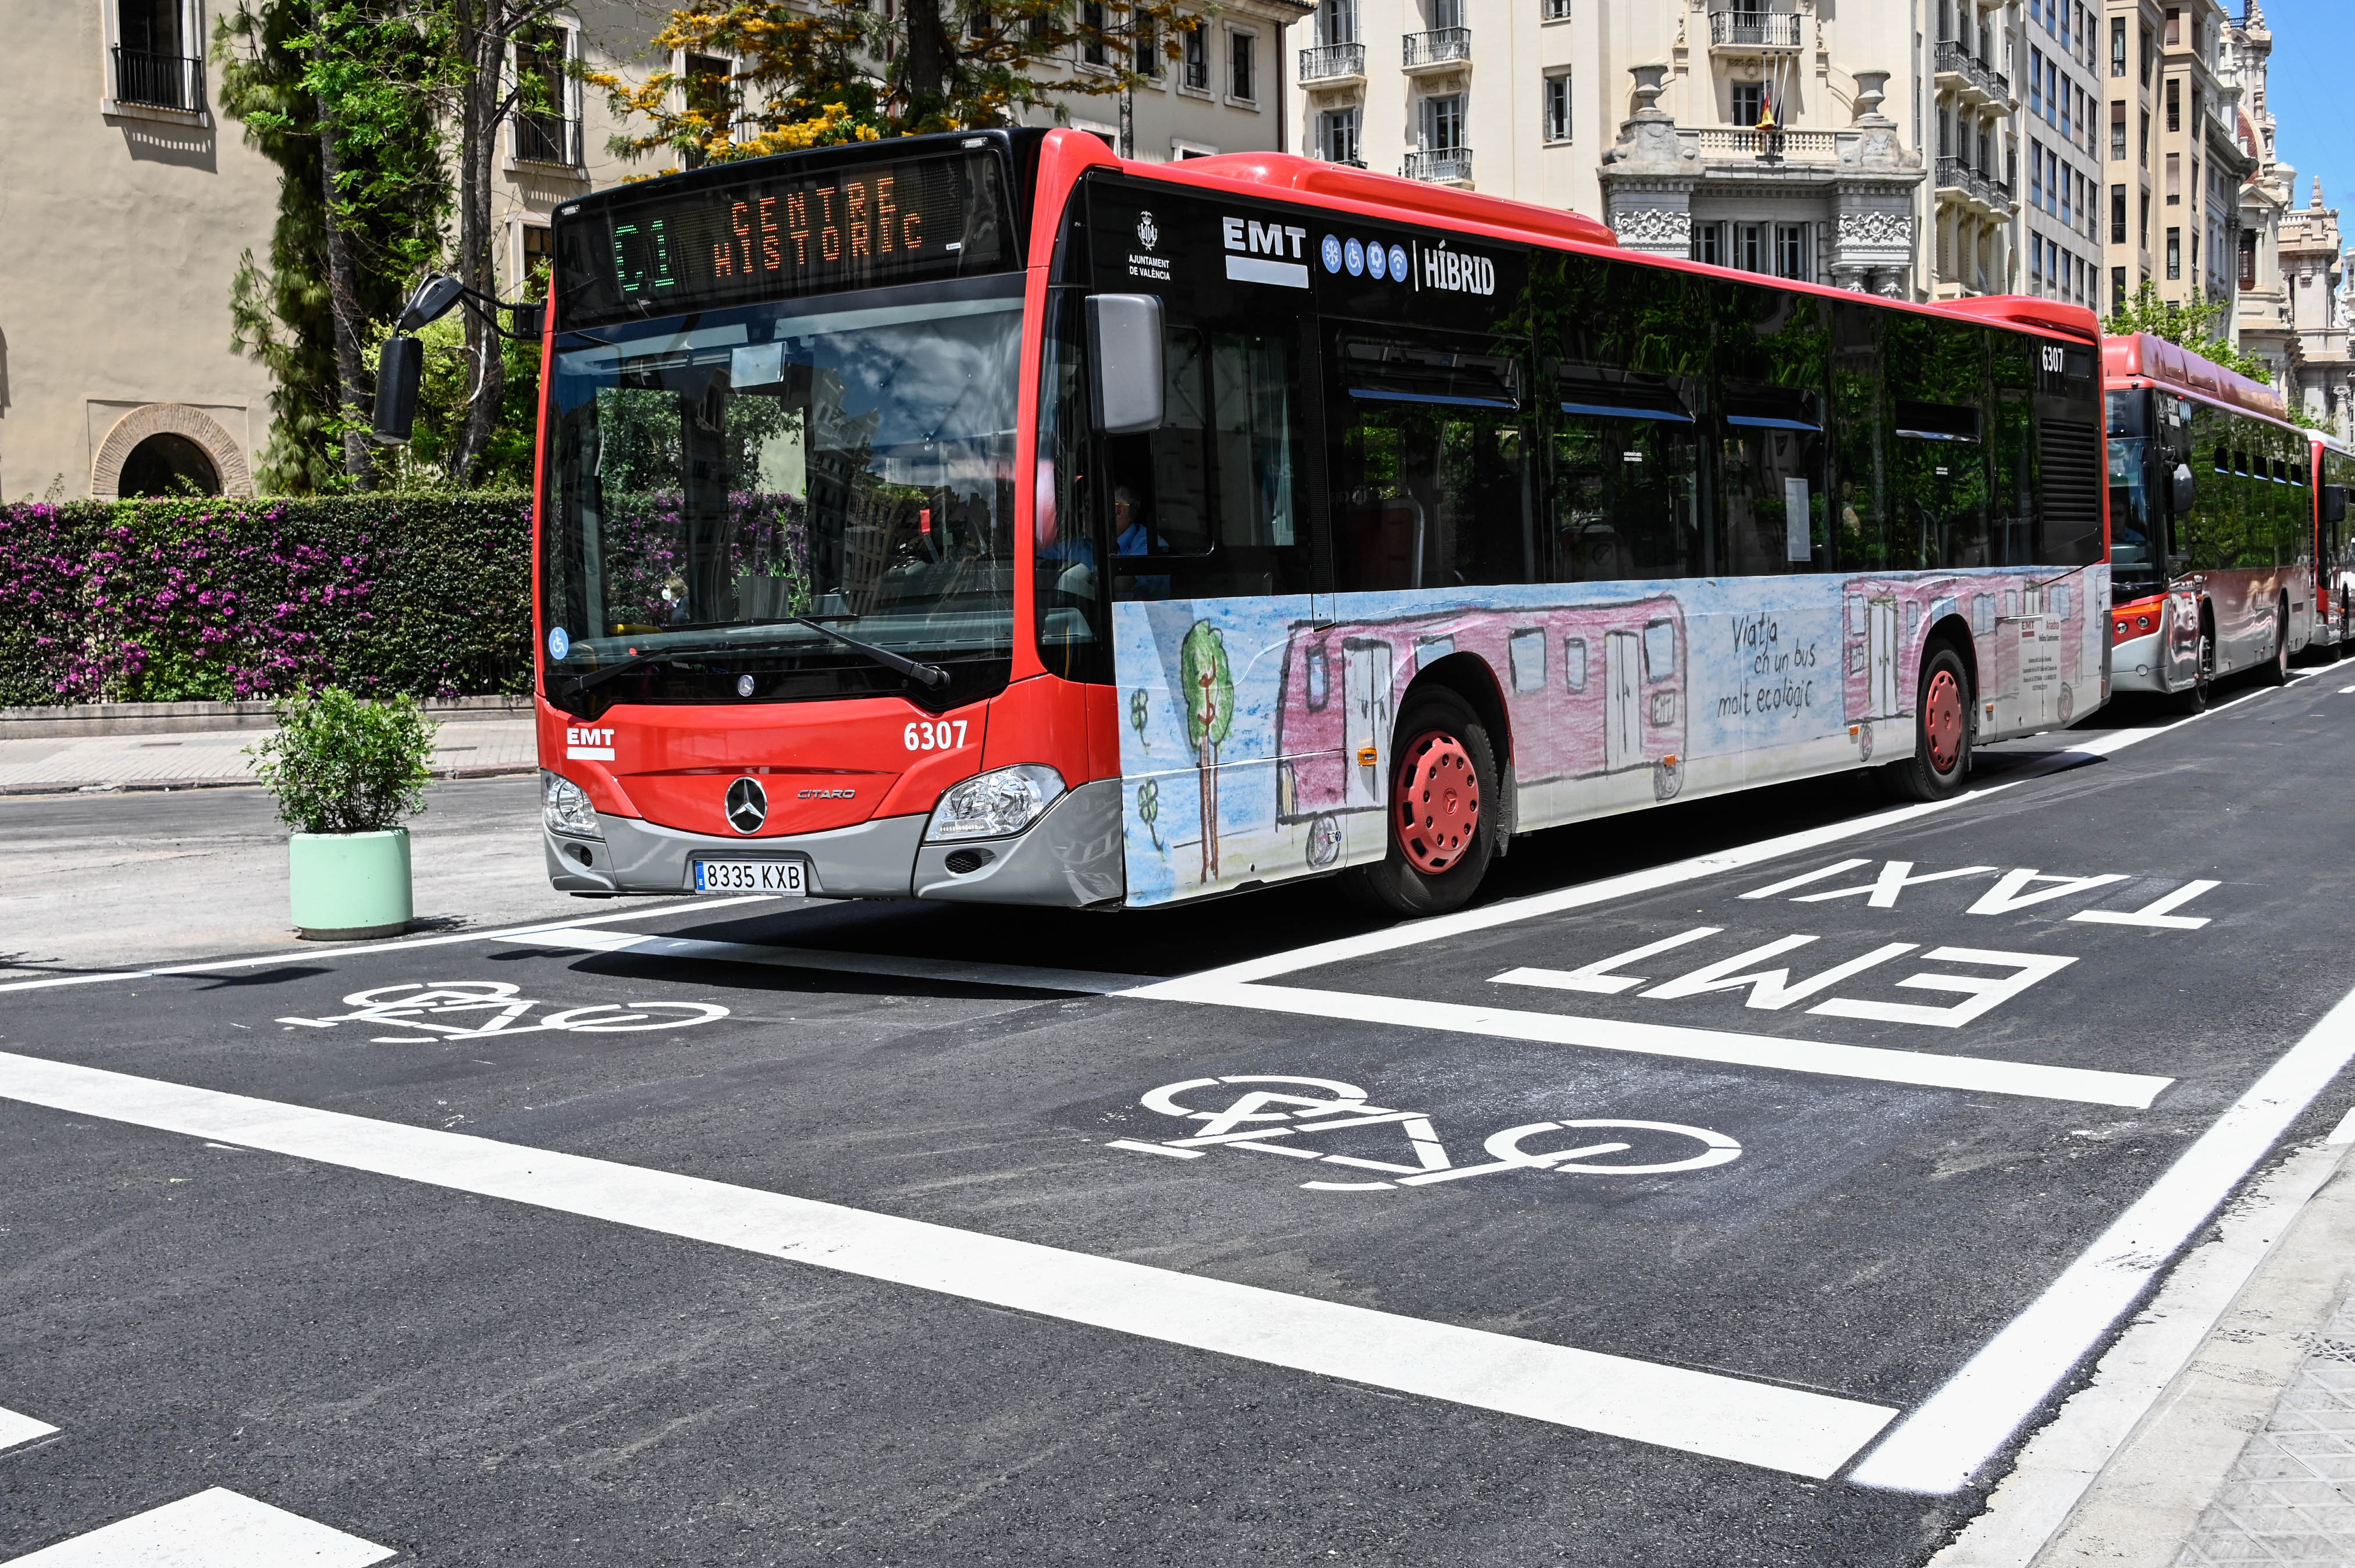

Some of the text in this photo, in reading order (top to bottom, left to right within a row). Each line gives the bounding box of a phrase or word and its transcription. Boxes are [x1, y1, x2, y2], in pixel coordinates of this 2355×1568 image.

[732, 177, 897, 236] CENTRE
[615, 220, 674, 291] C1
[714, 213, 922, 277] HISTORIC
[1223, 216, 1306, 258] EMT
[1129, 254, 1170, 269] AJUNTAMENT
[1129, 266, 1171, 281] DE VALÈNCIA
[1424, 239, 1495, 295] HÍBRID
[2042, 345, 2063, 372] 6307
[1733, 612, 1778, 659] Viatja
[2021, 621, 2035, 630] EMT
[1754, 637, 1816, 675] en un bus
[1718, 676, 1813, 719] molt ecològic
[567, 728, 615, 746] EMT
[904, 720, 968, 751] 6307
[798, 789, 855, 799] CITARO
[707, 865, 755, 888] 8335
[762, 865, 800, 889] KXB
[1736, 859, 2221, 929] TAXI
[1485, 927, 2080, 1028] EMT
